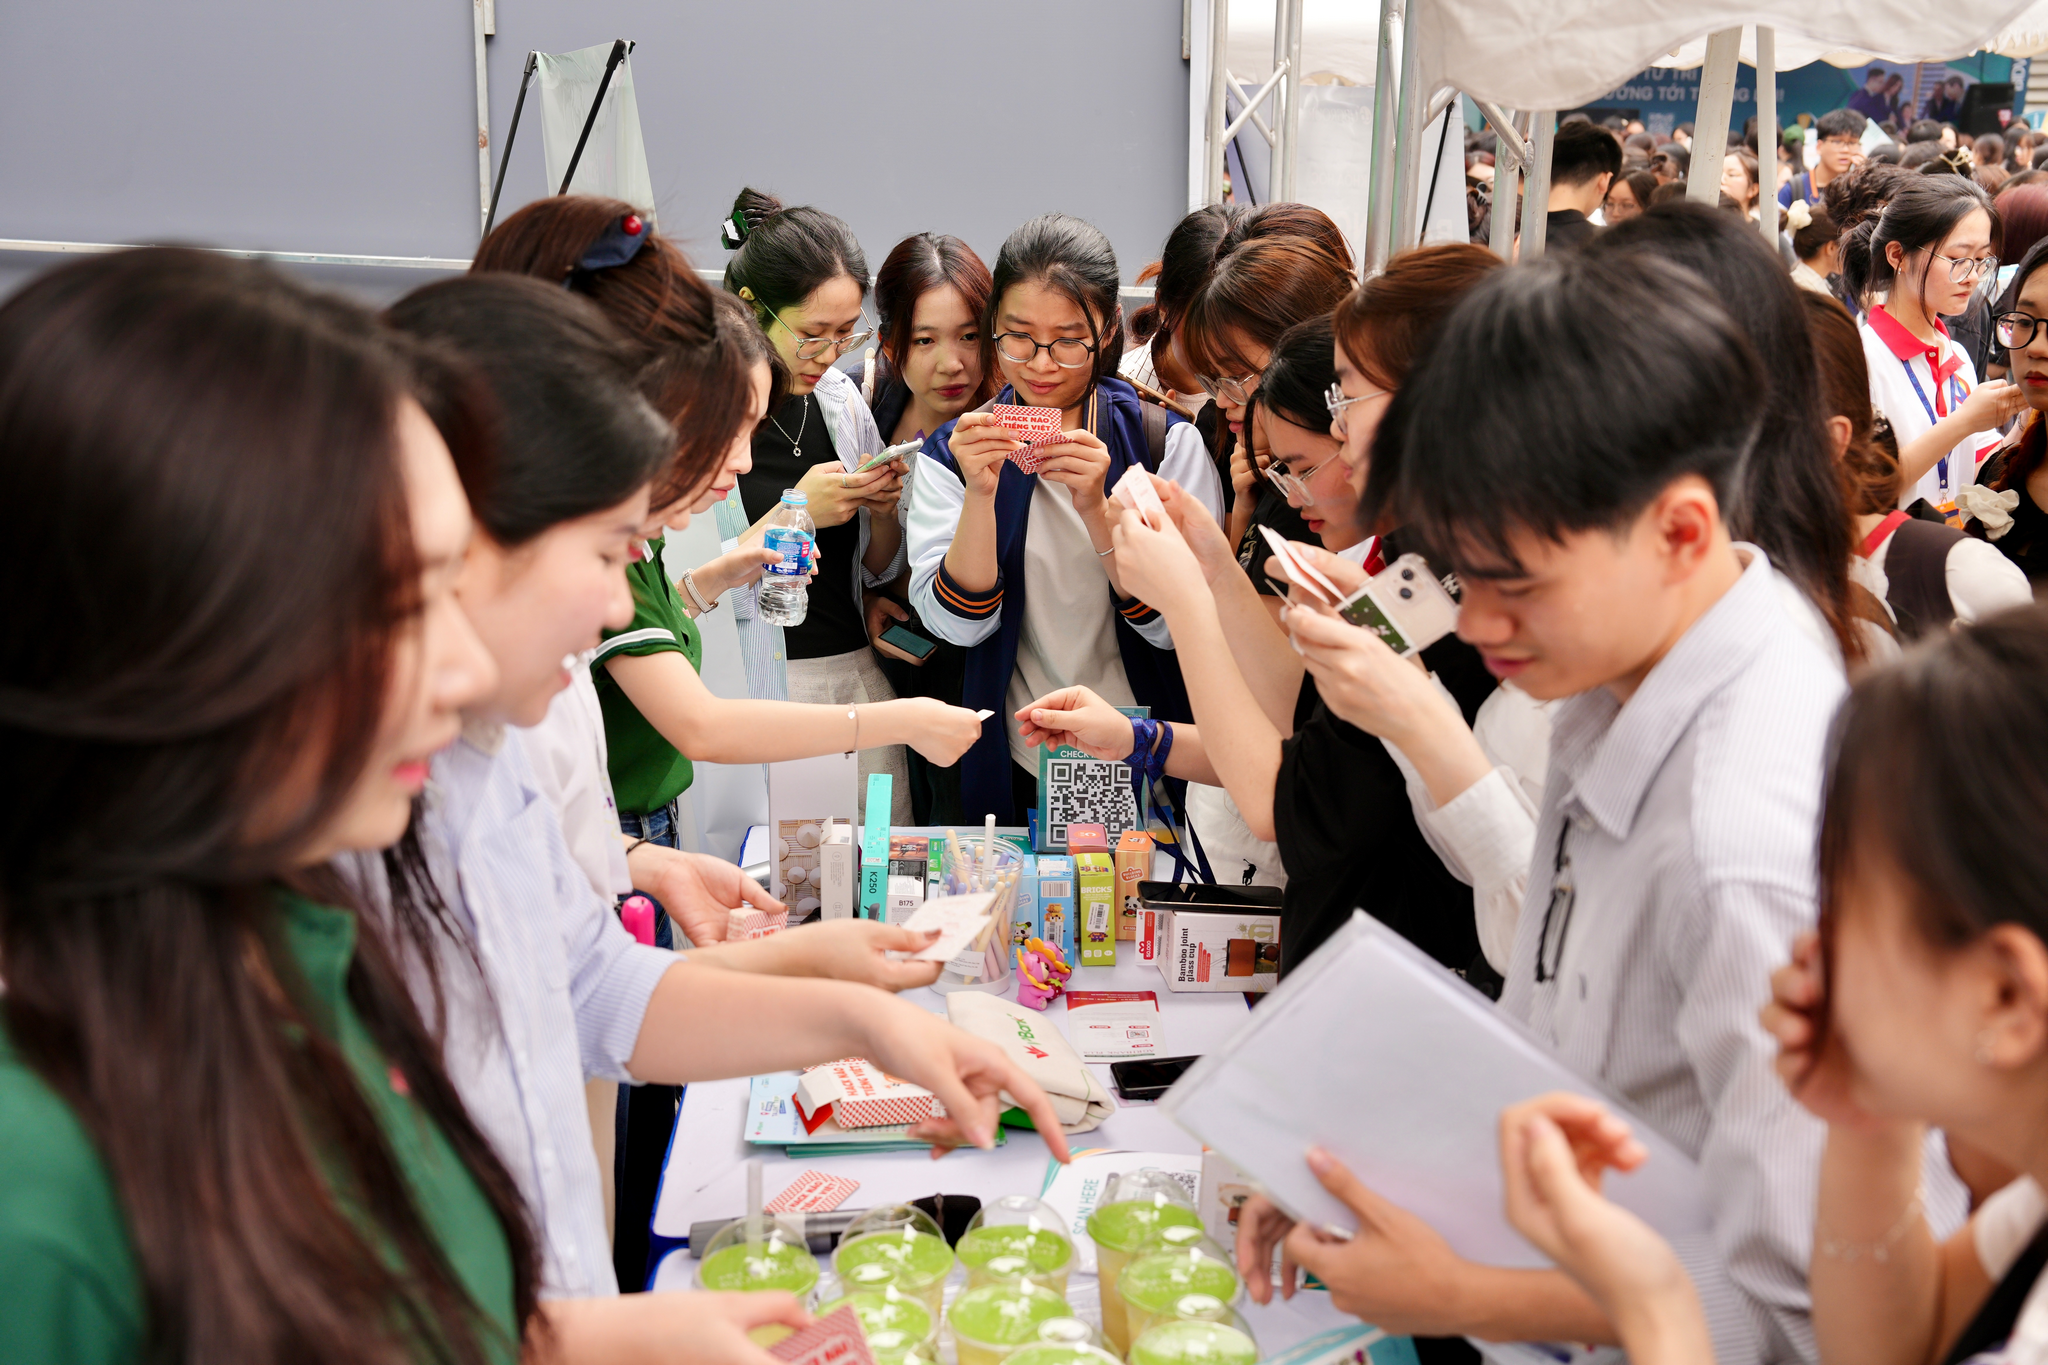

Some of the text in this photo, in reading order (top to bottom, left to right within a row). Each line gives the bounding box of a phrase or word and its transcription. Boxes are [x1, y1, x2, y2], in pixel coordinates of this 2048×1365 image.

[1060, 750, 1089, 759] CHECK
[868, 871, 878, 894] K250
[1081, 886, 1113, 894] BRICKS
[1178, 928, 1189, 982] Bamboo joint
[1186, 943, 1197, 982] glass cup
[1073, 1178, 1099, 1235] SCAN HERE
